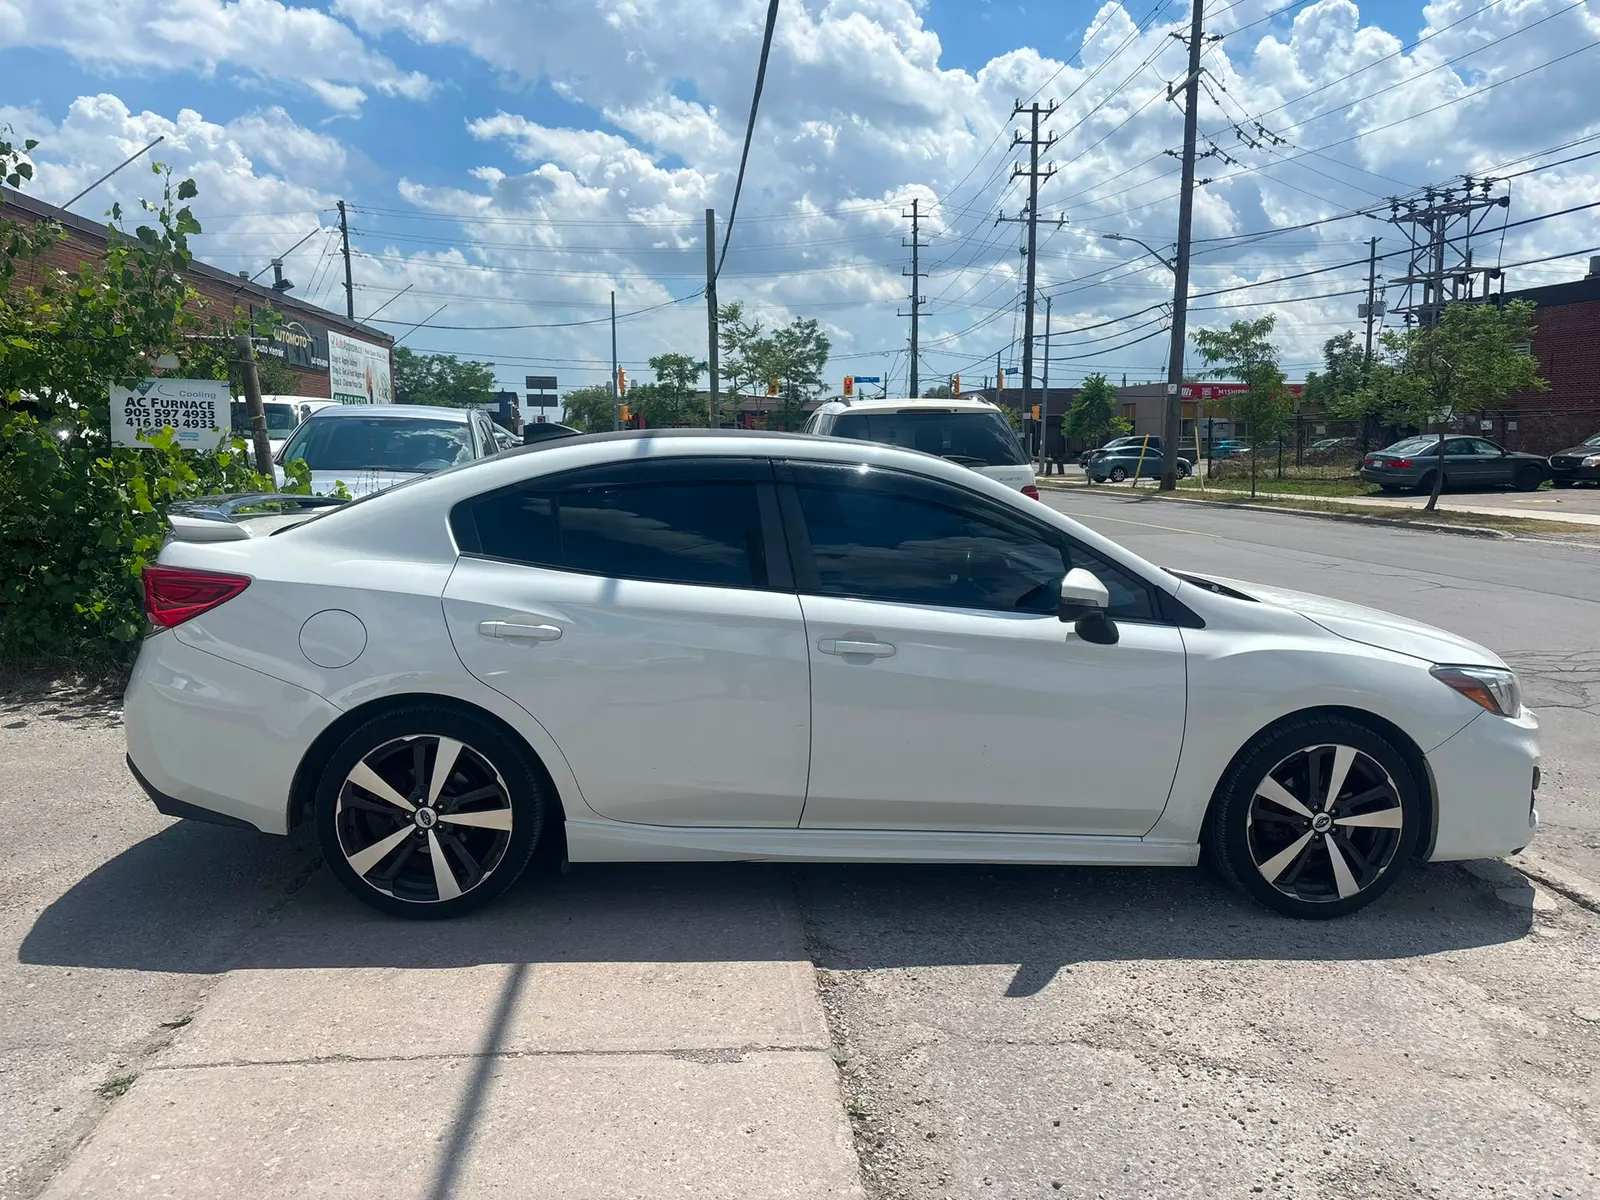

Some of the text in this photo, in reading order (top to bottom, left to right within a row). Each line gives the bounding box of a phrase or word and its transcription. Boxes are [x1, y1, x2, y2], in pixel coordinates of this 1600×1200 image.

[179, 391, 216, 399] Cooling
[125, 397, 215, 410] AC FURNACE
[124, 408, 215, 419] 905 597 4933
[125, 418, 215, 429] 416 893 4933
